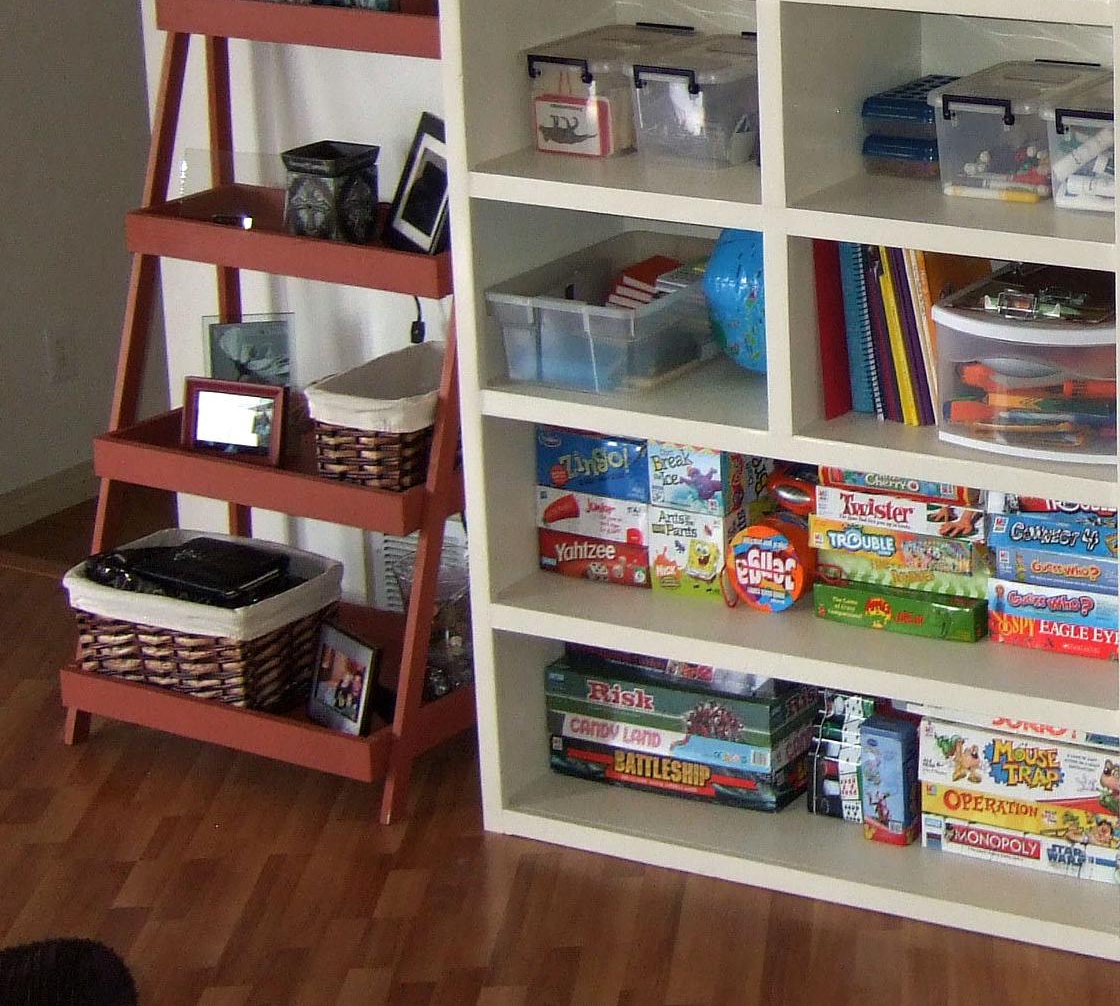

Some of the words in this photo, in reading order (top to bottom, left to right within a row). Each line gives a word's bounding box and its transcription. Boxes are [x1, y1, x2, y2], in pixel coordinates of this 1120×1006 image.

[651, 450, 694, 472] Break
[840, 491, 915, 525] Twister
[664, 523, 698, 539] Pants
[827, 529, 897, 553] TROUBLE
[1010, 521, 1080, 547] CONNECT
[1081, 527, 1100, 551] 4
[554, 541, 616, 562] Yahtzee
[1039, 619, 1089, 641] EAGLE
[586, 679, 655, 711] Risk
[992, 738, 1060, 767] MOUSE
[613, 750, 712, 788] BATTLESHIP
[1005, 763, 1060, 791] TRAP
[943, 788, 1040, 818] OPERATION
[954, 827, 1038, 856] MONOPOLY
